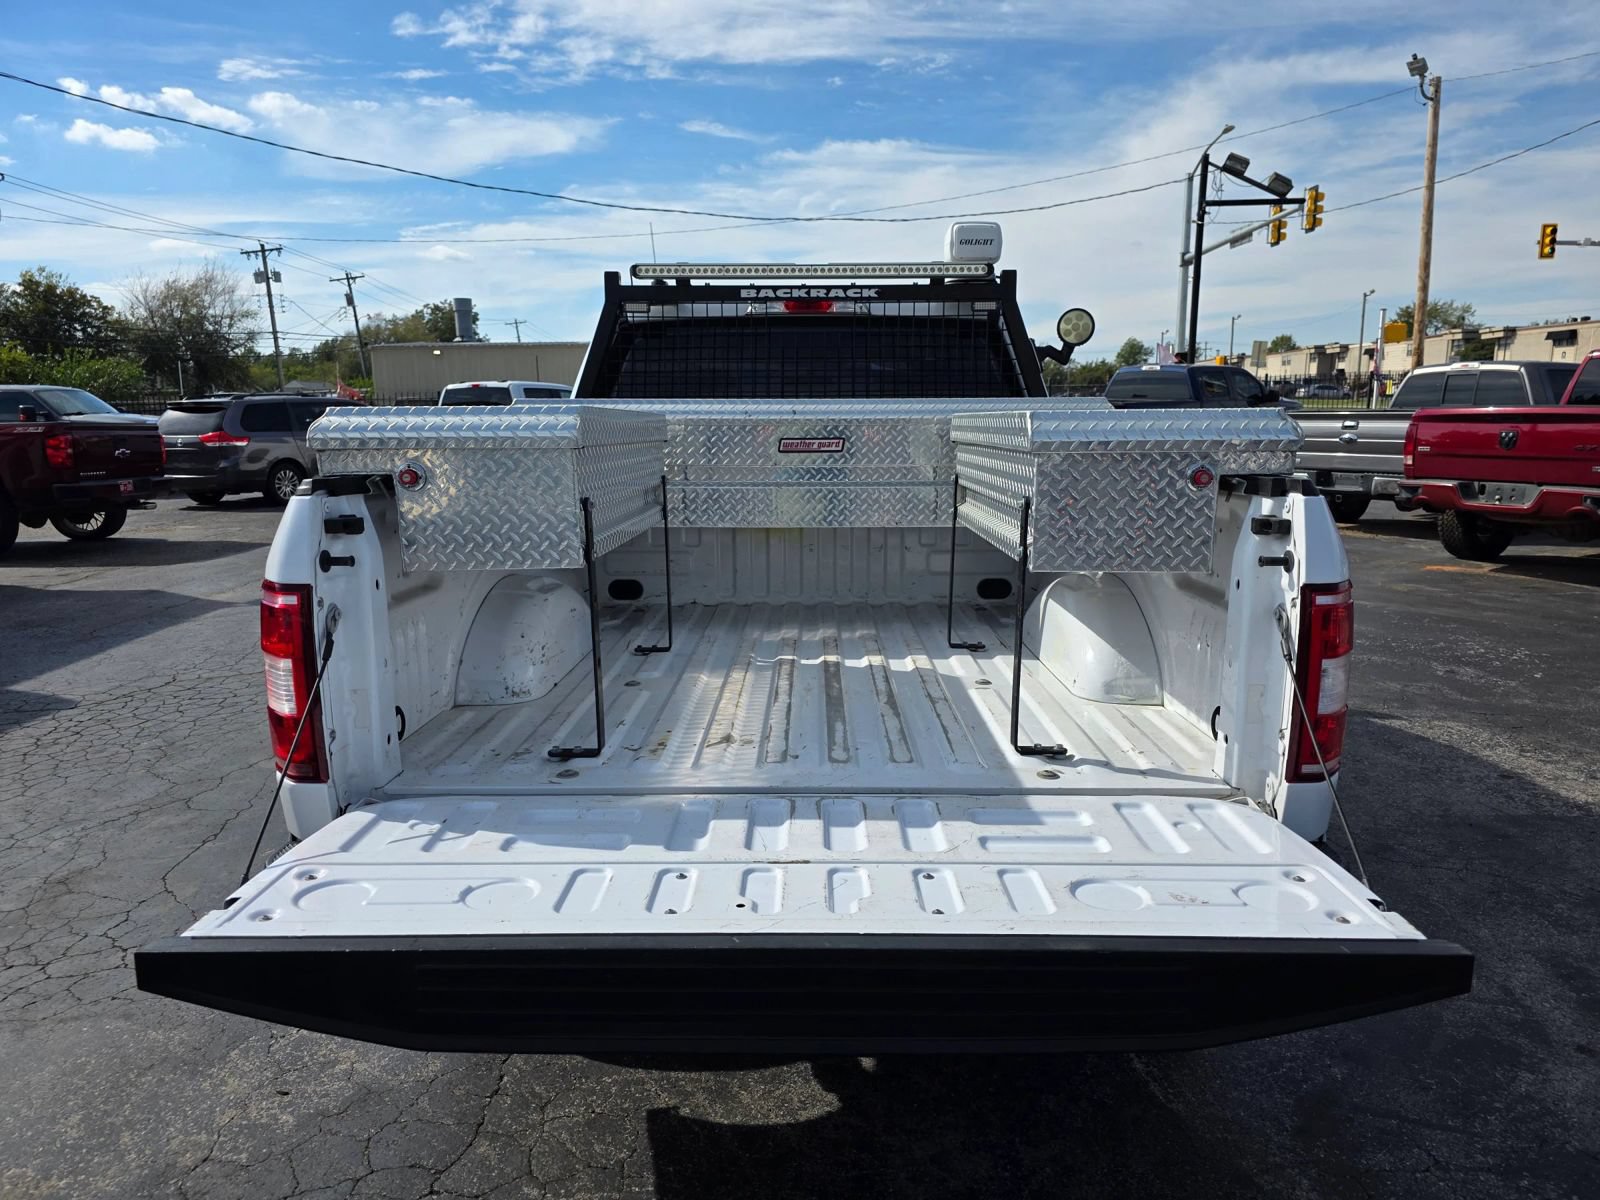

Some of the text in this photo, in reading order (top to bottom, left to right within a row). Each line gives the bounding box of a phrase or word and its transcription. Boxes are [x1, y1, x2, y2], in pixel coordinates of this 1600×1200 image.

[959, 238, 995, 246] GOLIGHT
[740, 288, 879, 298] BACKRACK
[782, 440, 841, 449] weather guard
